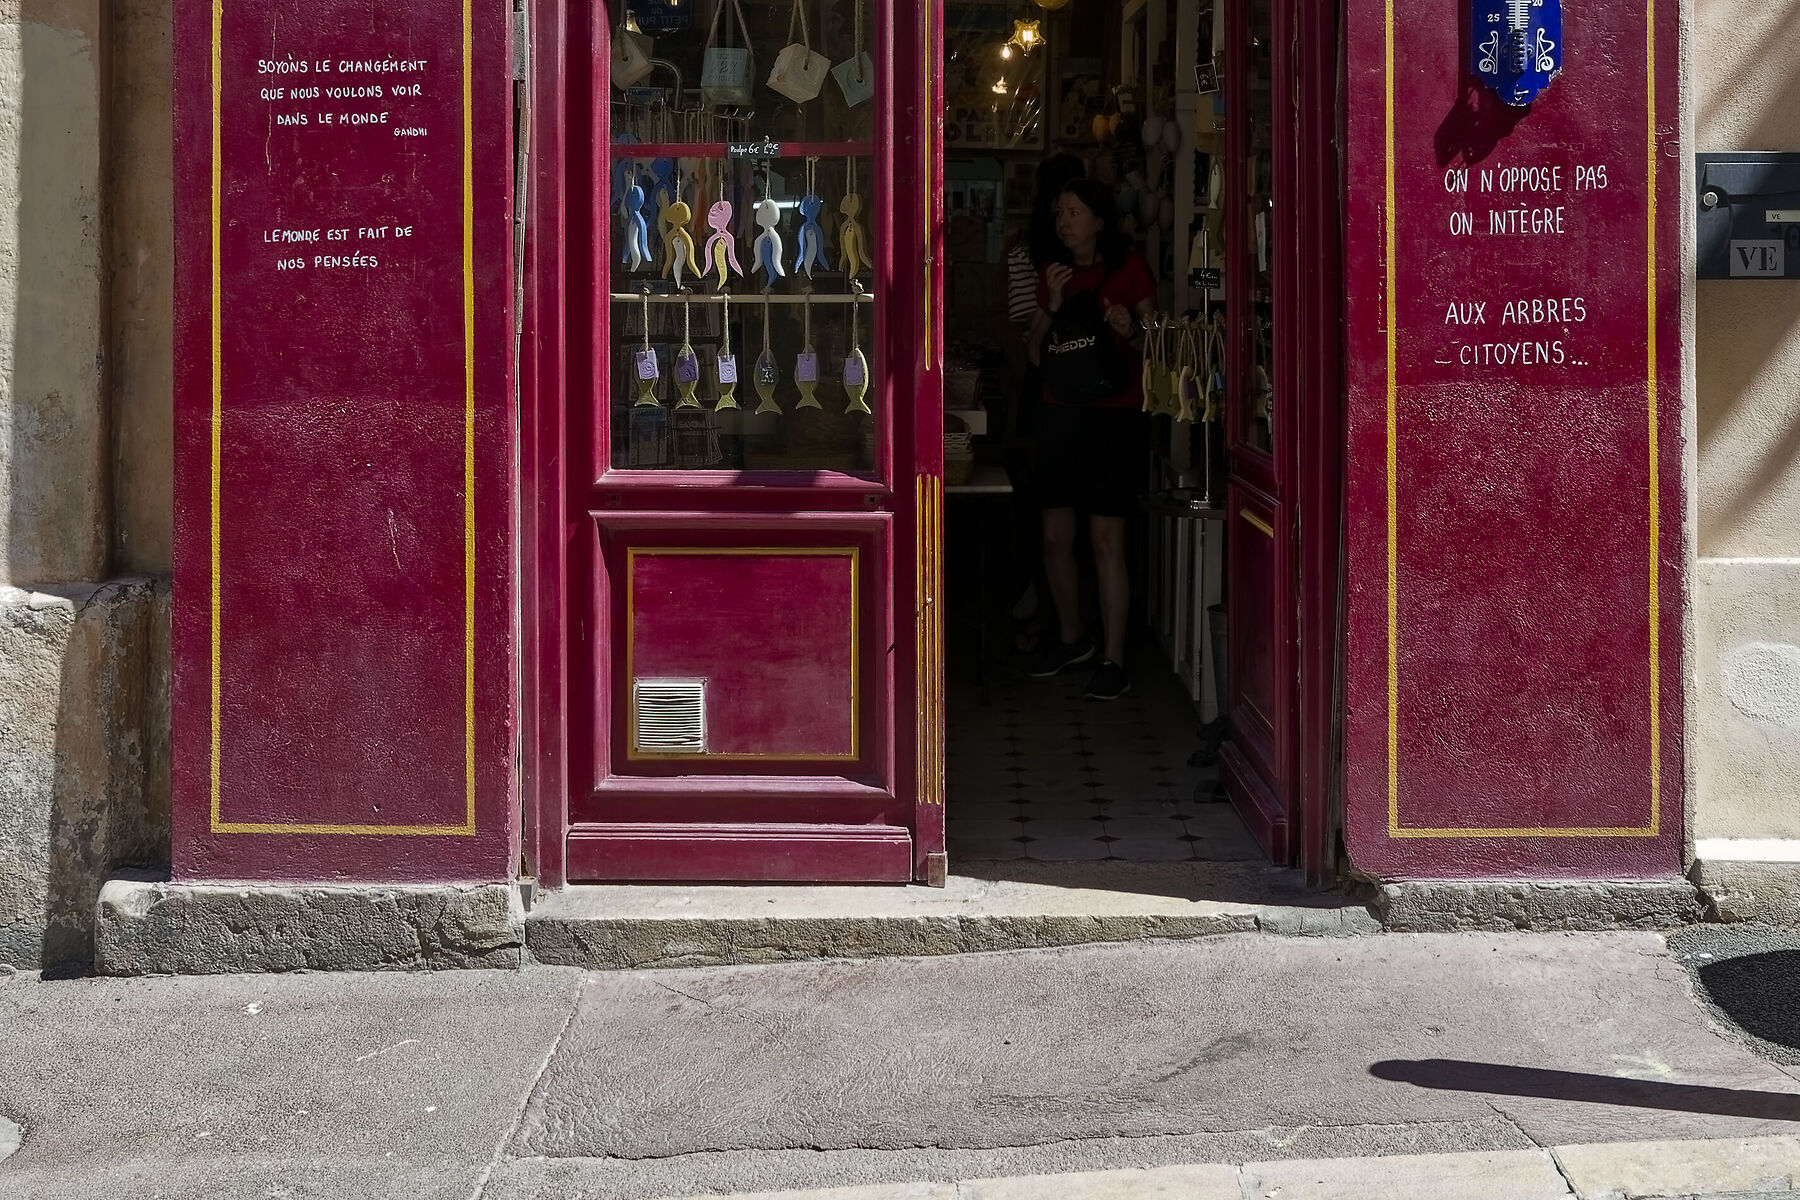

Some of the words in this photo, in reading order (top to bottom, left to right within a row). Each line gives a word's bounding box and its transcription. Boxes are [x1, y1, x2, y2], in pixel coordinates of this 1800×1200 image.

[1487, 14, 1501, 22] 25
[258, 59, 309, 75] SOYONS
[315, 59, 331, 73] LE
[338, 59, 428, 74] CHANGEMENT
[260, 88, 285, 101] QUE
[290, 86, 320, 100] NOUS
[326, 85, 383, 99] VOULONS
[391, 83, 422, 97] VOIR
[277, 112, 308, 126] DANS
[318, 112, 333, 124] LE
[339, 111, 389, 125] MONDE
[393, 127, 428, 137] GANDHI
[1444, 167, 1469, 193] ON
[1575, 165, 1608, 191] PAS
[1449, 211, 1473, 236] ON
[327, 228, 350, 241] EST
[358, 226, 389, 240] FAIT
[395, 225, 413, 238] DE
[277, 257, 306, 271] NOS
[314, 250, 379, 269] PENSÉES
[1735, 246, 1778, 272] VE
[1444, 301, 1487, 325] AUX
[1501, 297, 1587, 326] ARBRES
